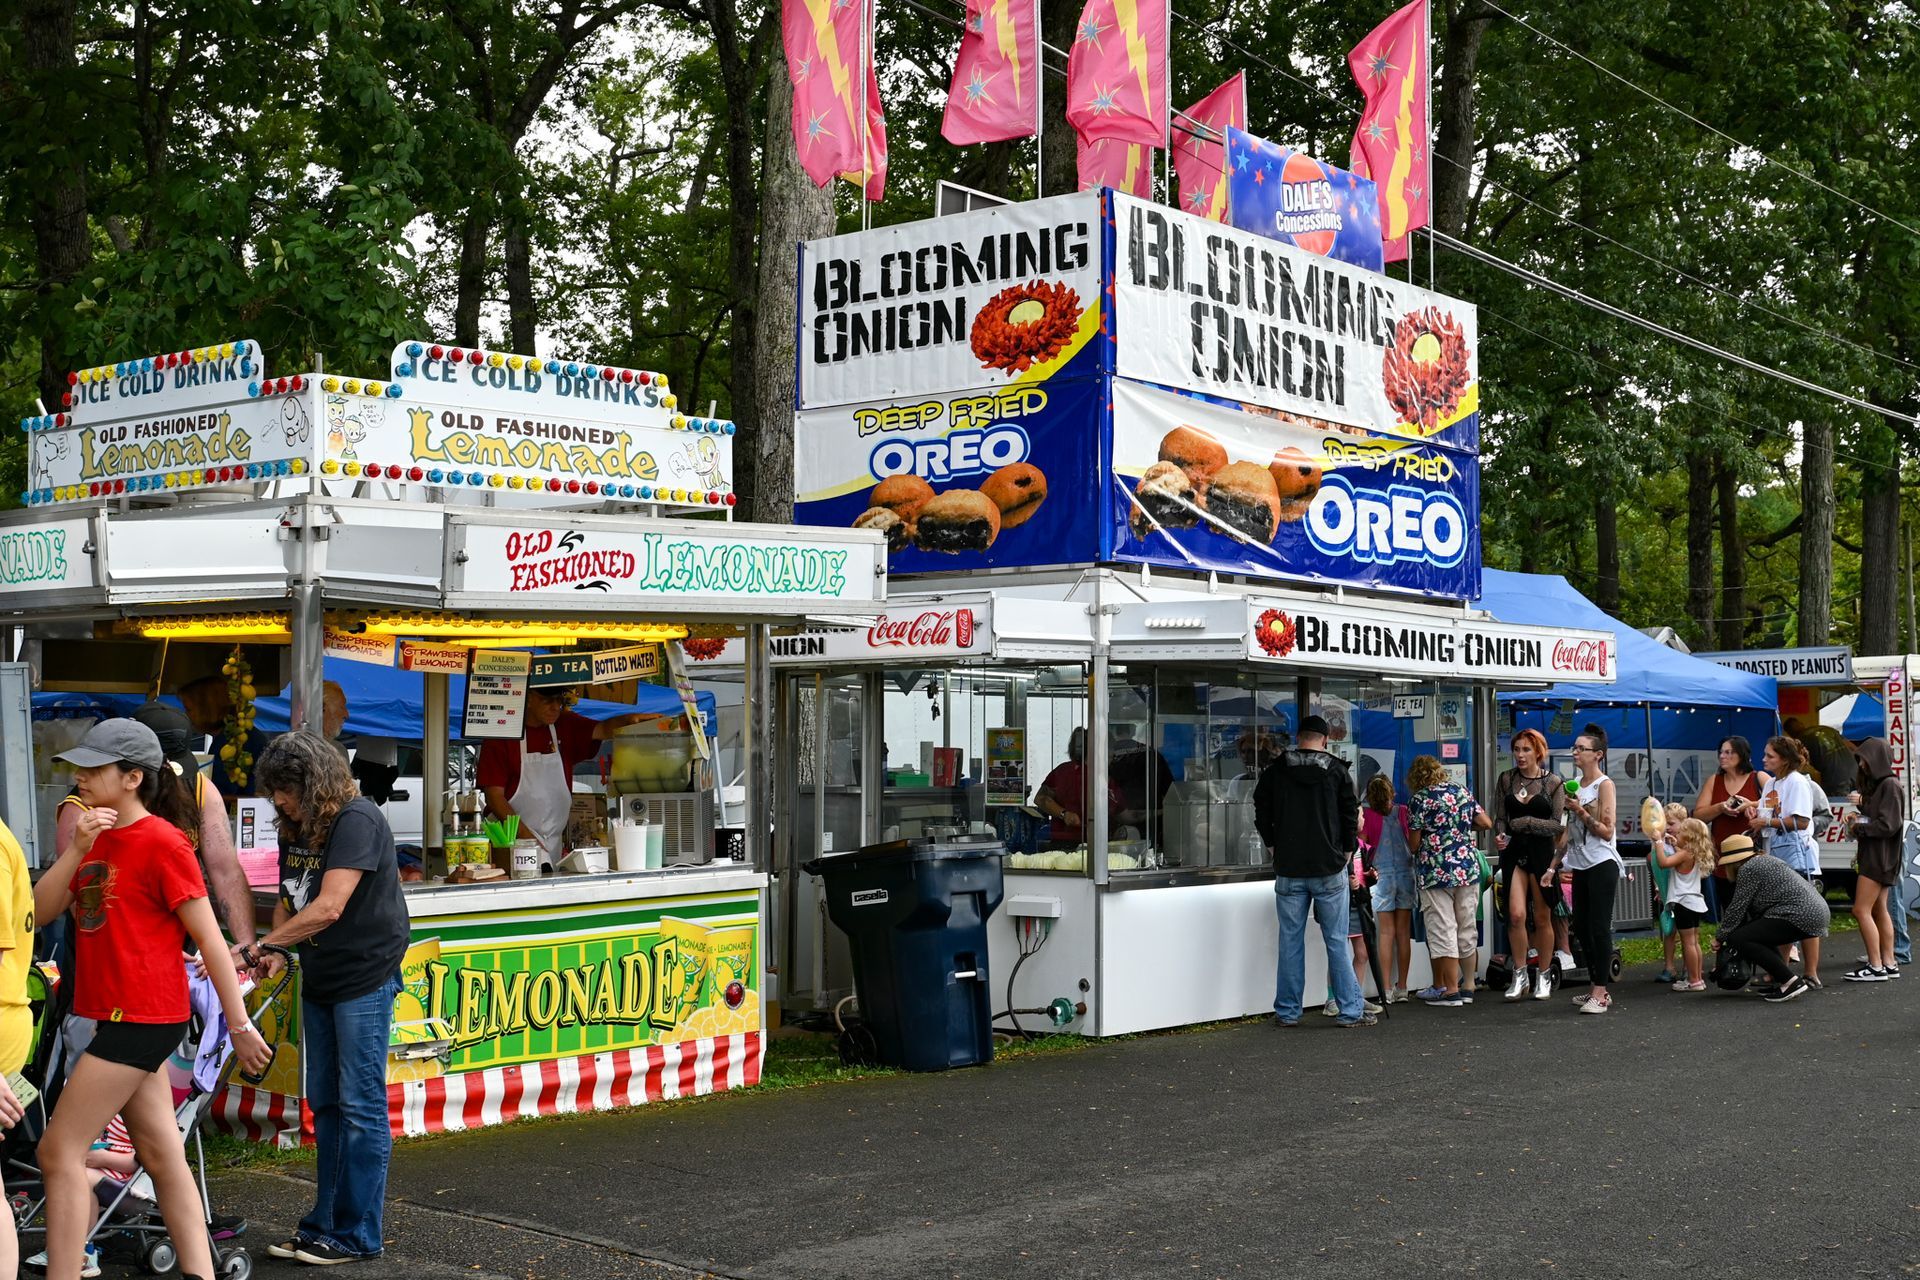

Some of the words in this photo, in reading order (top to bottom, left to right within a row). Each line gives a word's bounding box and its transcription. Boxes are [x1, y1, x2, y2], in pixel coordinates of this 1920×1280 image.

[1281, 180, 1334, 213] DALE'S
[1275, 209, 1343, 232] Concessions
[814, 222, 1089, 312] BLOOMING
[1128, 205, 1396, 350] BLOOMING
[814, 296, 967, 364] ONION
[1190, 300, 1346, 406] ONION
[81, 380, 111, 404] ICE
[118, 370, 165, 398] COLD
[409, 357, 458, 384] ICE
[471, 363, 542, 394] COLD
[555, 373, 659, 408] DRINKS
[99, 425, 128, 445] OLD
[134, 413, 218, 439] FASHIONED
[440, 410, 484, 431] OLD
[496, 417, 615, 446] FASHIONED
[853, 400, 943, 437] DEEP
[949, 388, 1049, 428] FRIED
[79, 409, 252, 481] Lemonade
[407, 406, 660, 482] Lemonade
[871, 429, 1026, 481] OREO
[1322, 437, 1391, 473] DEEP
[1392, 453, 1454, 484] FRIED
[1307, 484, 1465, 560] OREO
[505, 530, 552, 561] OLD
[509, 550, 636, 592] FASHIONED
[640, 532, 847, 597] LEMONADE
[324, 630, 390, 650] RASPBERRY
[769, 637, 824, 656] NION
[866, 611, 956, 648] Coca-Cola
[1295, 615, 1456, 664] BLOOMING
[1464, 633, 1542, 668] ONION
[330, 641, 384, 657] LEMONADE
[404, 646, 469, 659] STRAWBERR
[414, 658, 464, 669] LEMONADE
[594, 656, 628, 677] BOTTLED
[629, 652, 656, 671] WATER
[1551, 639, 1598, 673] Coca-Cola
[1791, 656, 1846, 676] PEANUTS
[478, 664, 526, 673] CONCESSIONS
[530, 662, 553, 676] ED
[562, 660, 589, 674] TEA
[1394, 699, 1406, 710] ICE
[1409, 698, 1423, 710] TEA
[1888, 682, 1905, 778] PEANUT
[515, 855, 537, 865] TIPS
[853, 890, 887, 902] casella
[679, 938, 707, 953] MONADE
[717, 941, 748, 954] LEMONADE
[428, 936, 679, 1050] LEMONADE
